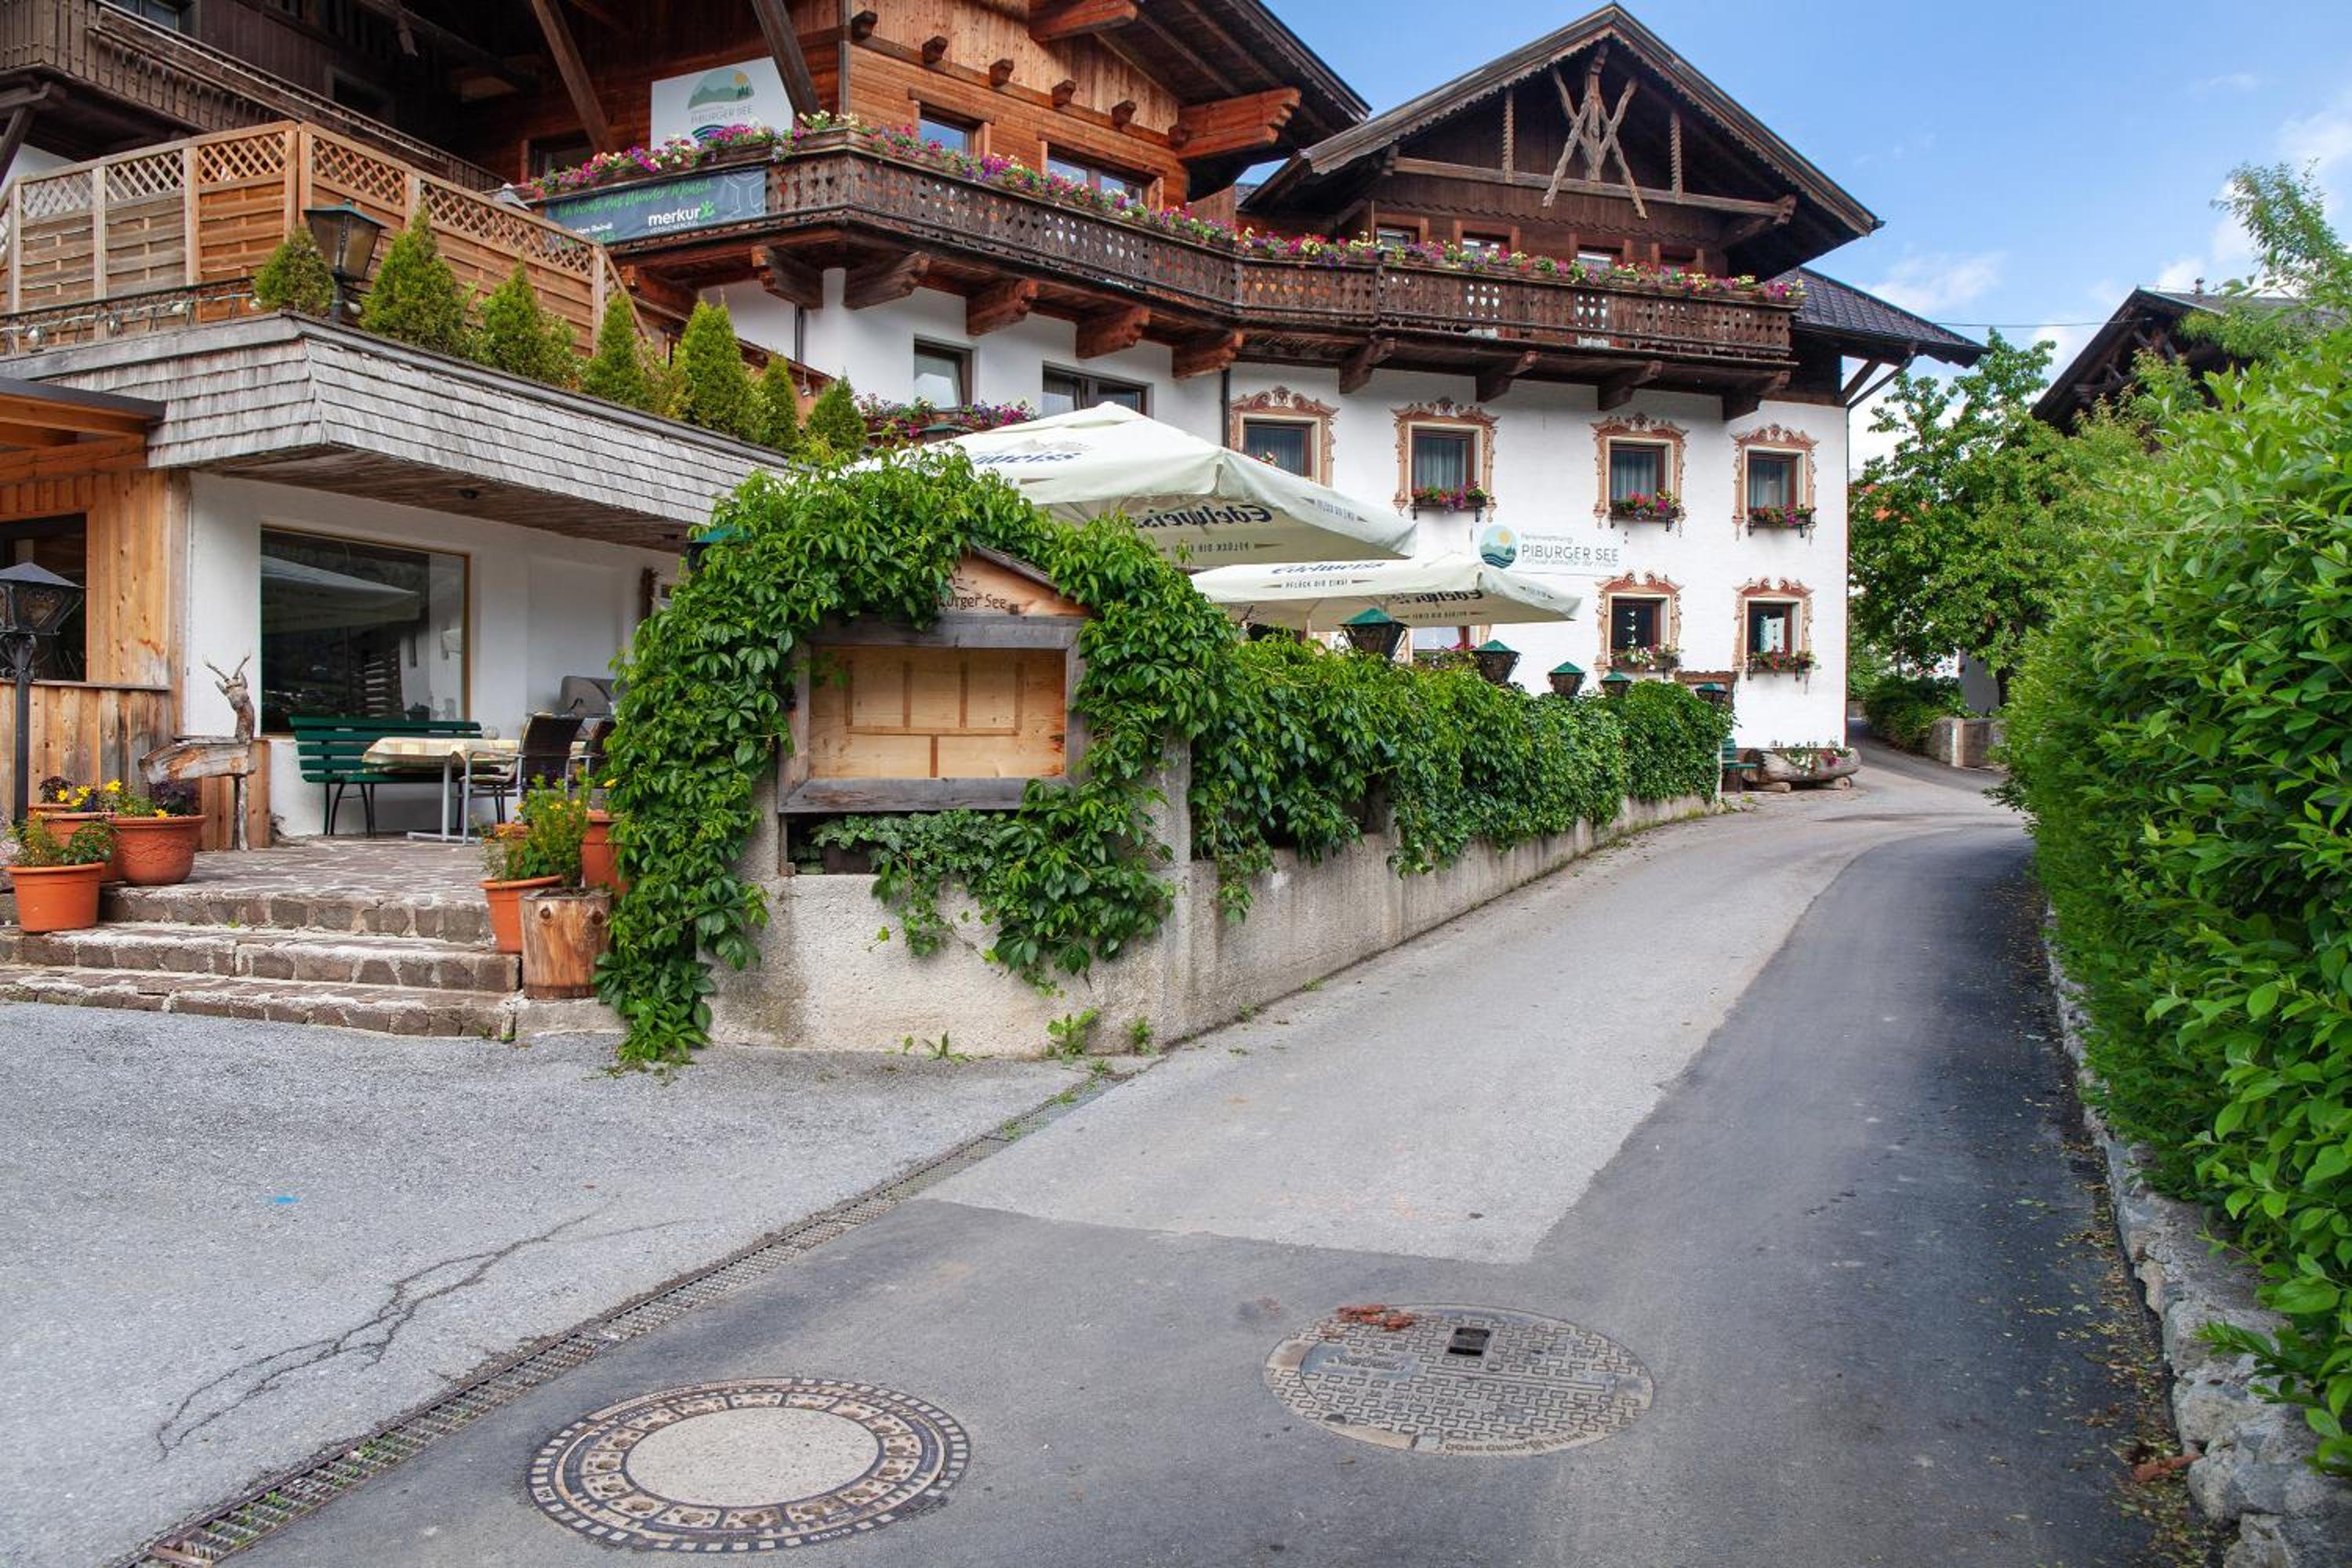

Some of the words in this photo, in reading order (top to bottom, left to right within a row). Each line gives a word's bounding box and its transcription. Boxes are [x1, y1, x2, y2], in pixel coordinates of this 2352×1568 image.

[737, 104, 753, 116] SEE
[648, 207, 702, 227] merkur
[1522, 544, 1591, 561] PIBURGER
[1595, 548, 1619, 562] SEE
[939, 594, 981, 611] urger
[985, 593, 1007, 609] See
